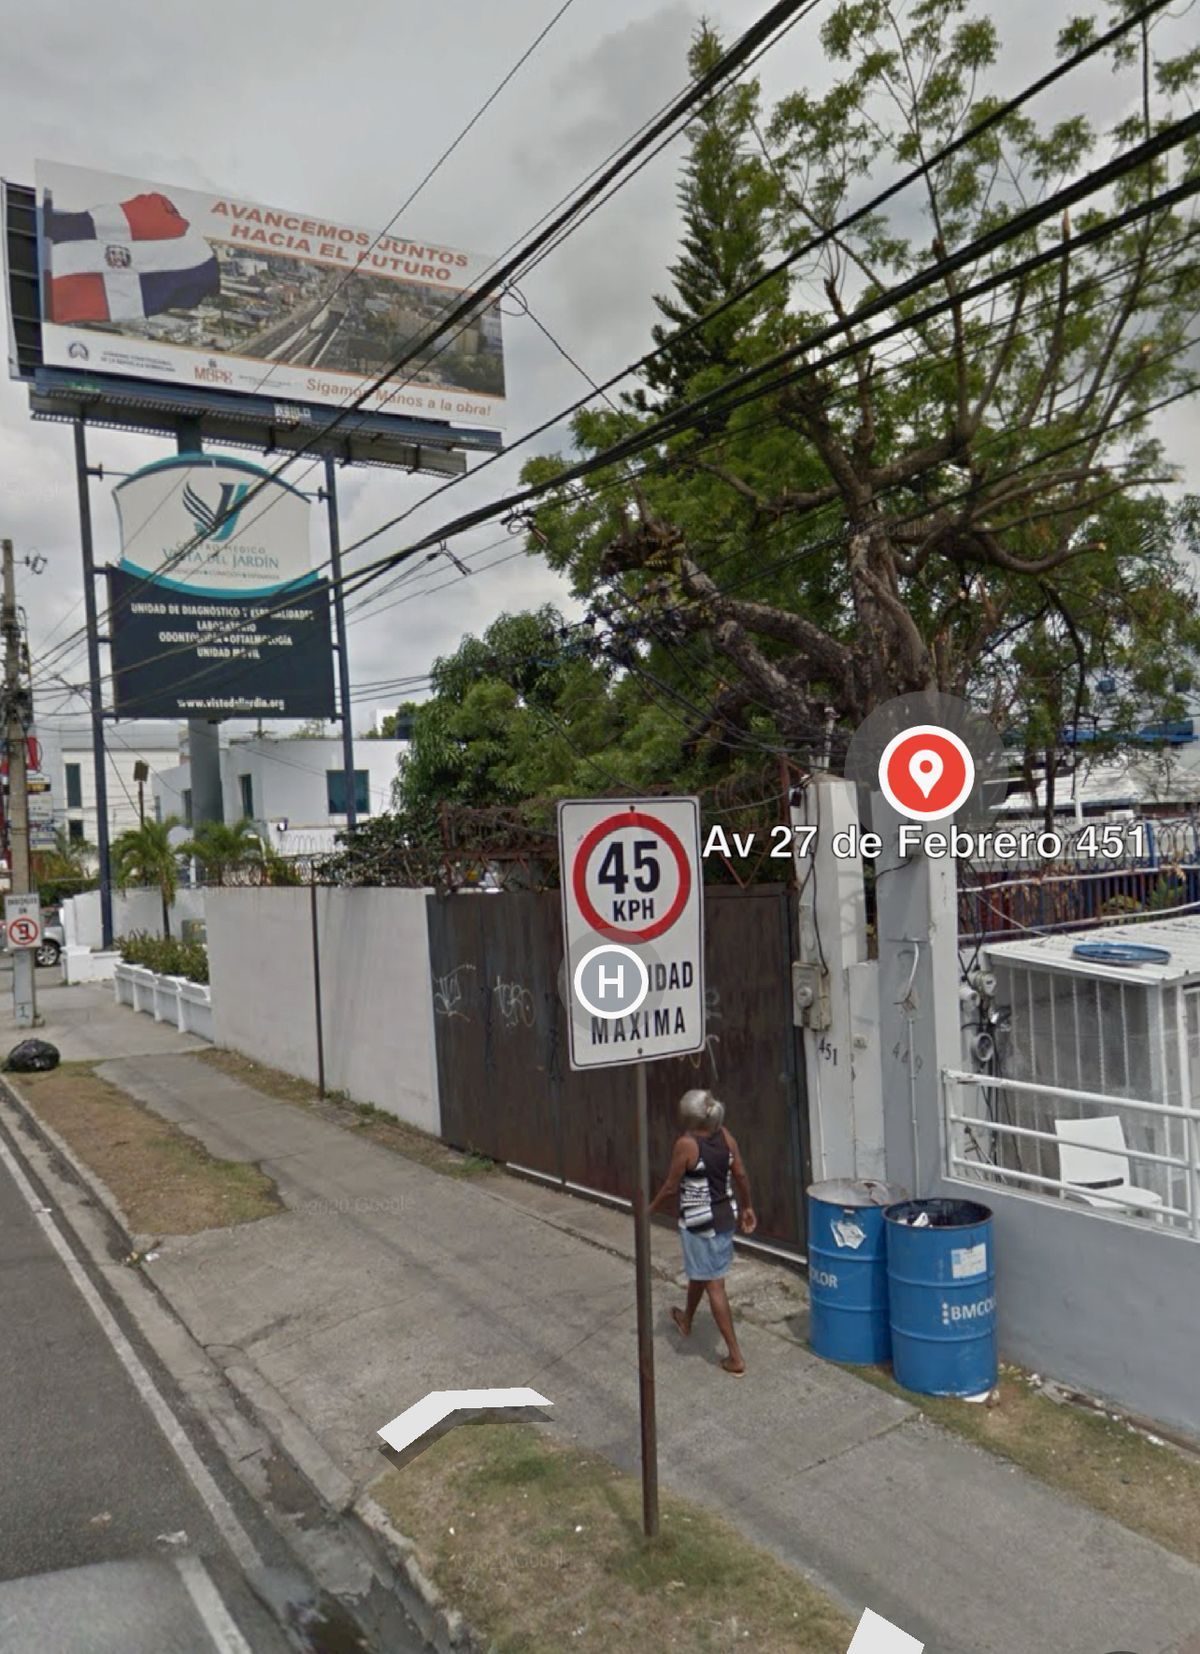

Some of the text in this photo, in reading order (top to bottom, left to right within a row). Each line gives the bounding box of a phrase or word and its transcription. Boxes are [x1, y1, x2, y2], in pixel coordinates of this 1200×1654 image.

[211, 200, 468, 267] AVANCEMOS JUNTOS
[231, 224, 452, 280] HACIA EL FUTURO
[306, 378, 368, 398] Sigamo
[441, 399, 451, 411] la
[456, 402, 491, 416] obra!
[131, 603, 167, 615] UNIDAD
[168, 605, 180, 615] DE
[196, 646, 231, 657] UNIDAD
[597, 840, 660, 895] 45
[613, 898, 654, 922] KPH
